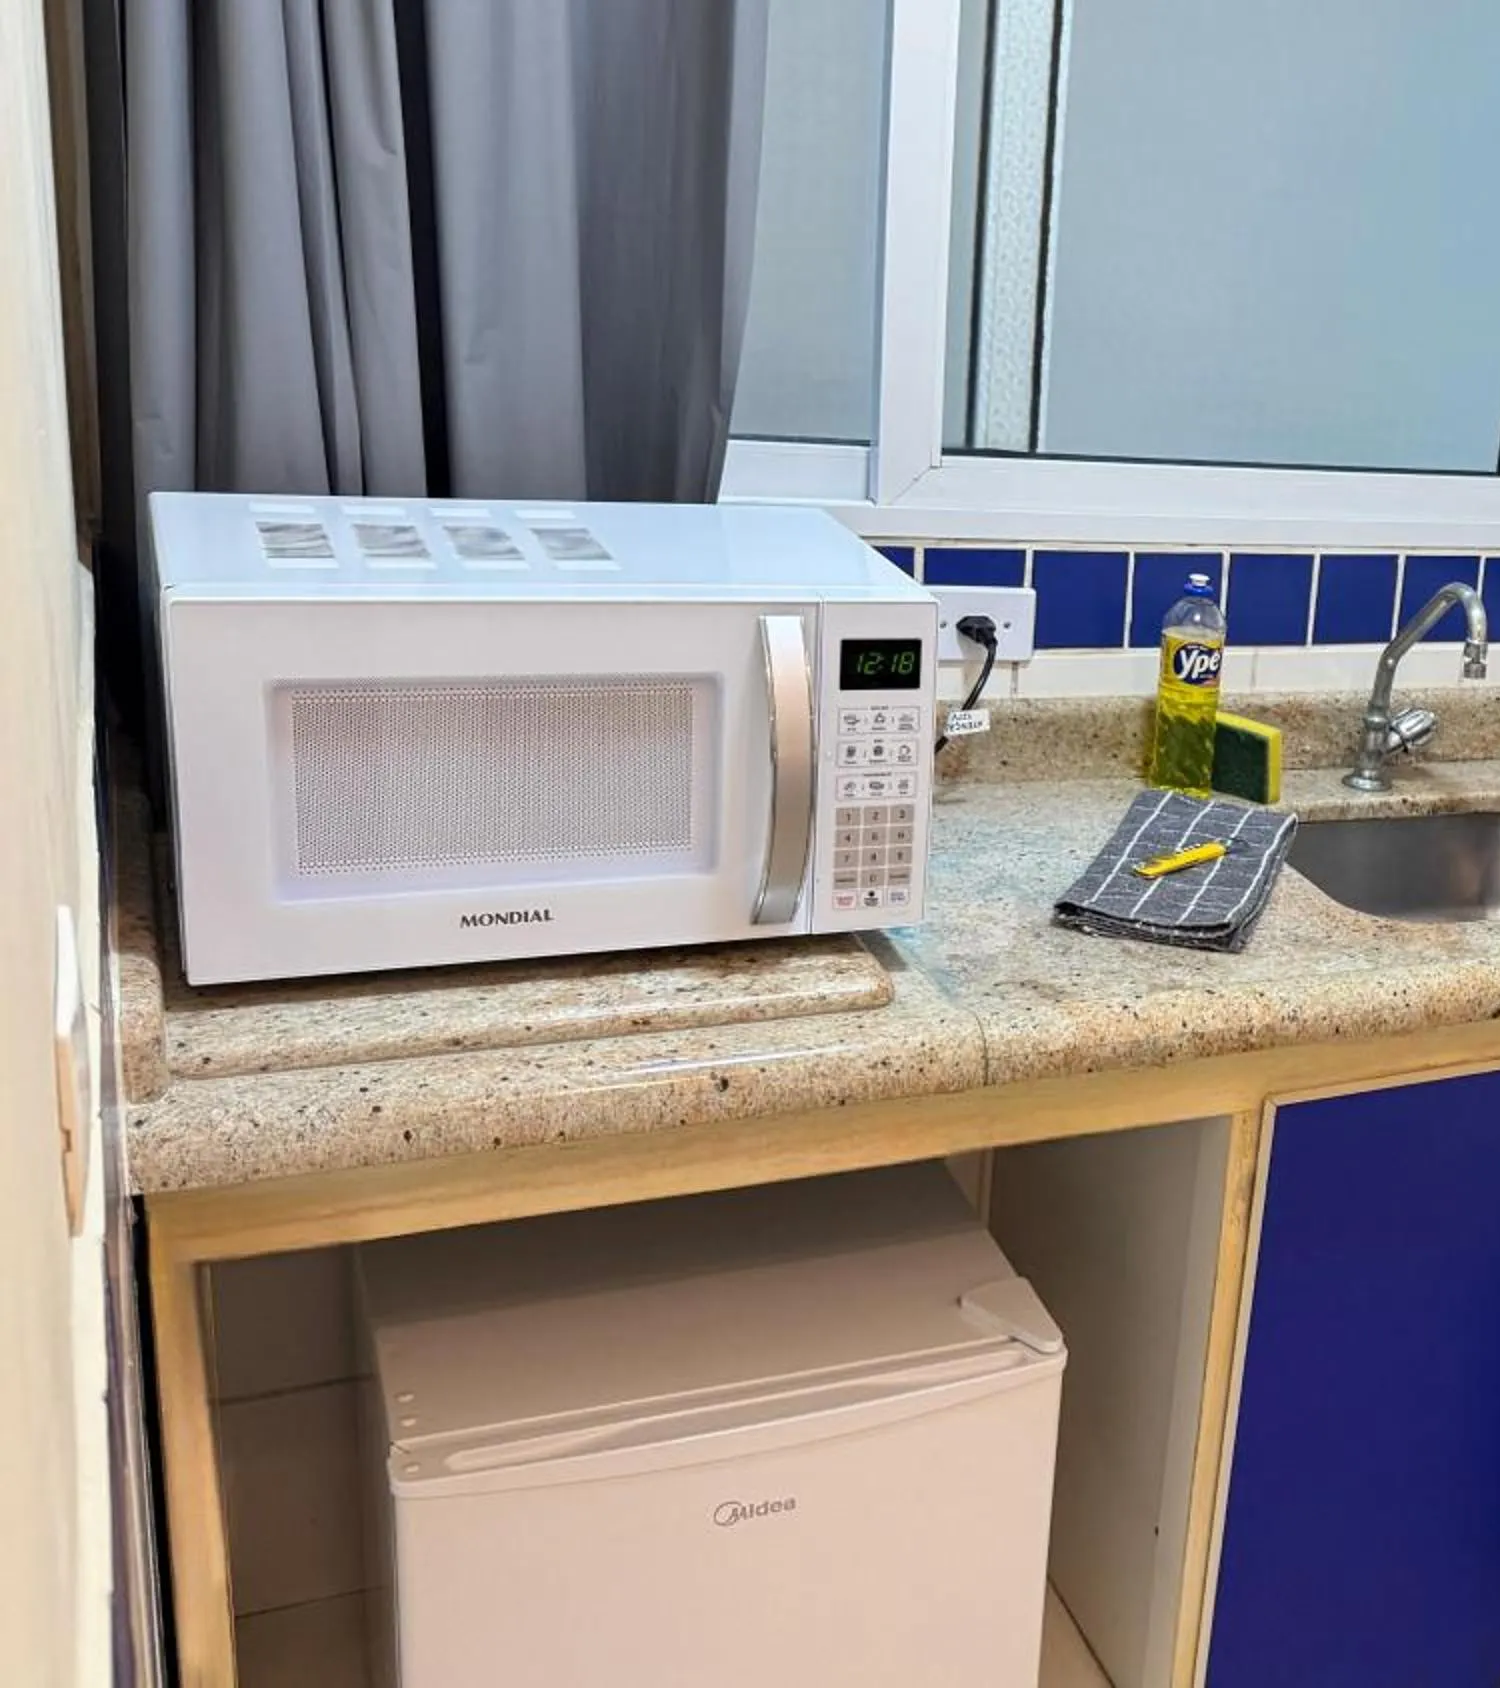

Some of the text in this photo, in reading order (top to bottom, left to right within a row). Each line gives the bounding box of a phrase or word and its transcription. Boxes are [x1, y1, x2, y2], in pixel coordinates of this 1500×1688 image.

[856, 652, 915, 676] 12:18
[460, 909, 555, 928] MONDIAL
[713, 1498, 796, 1527] Midea
